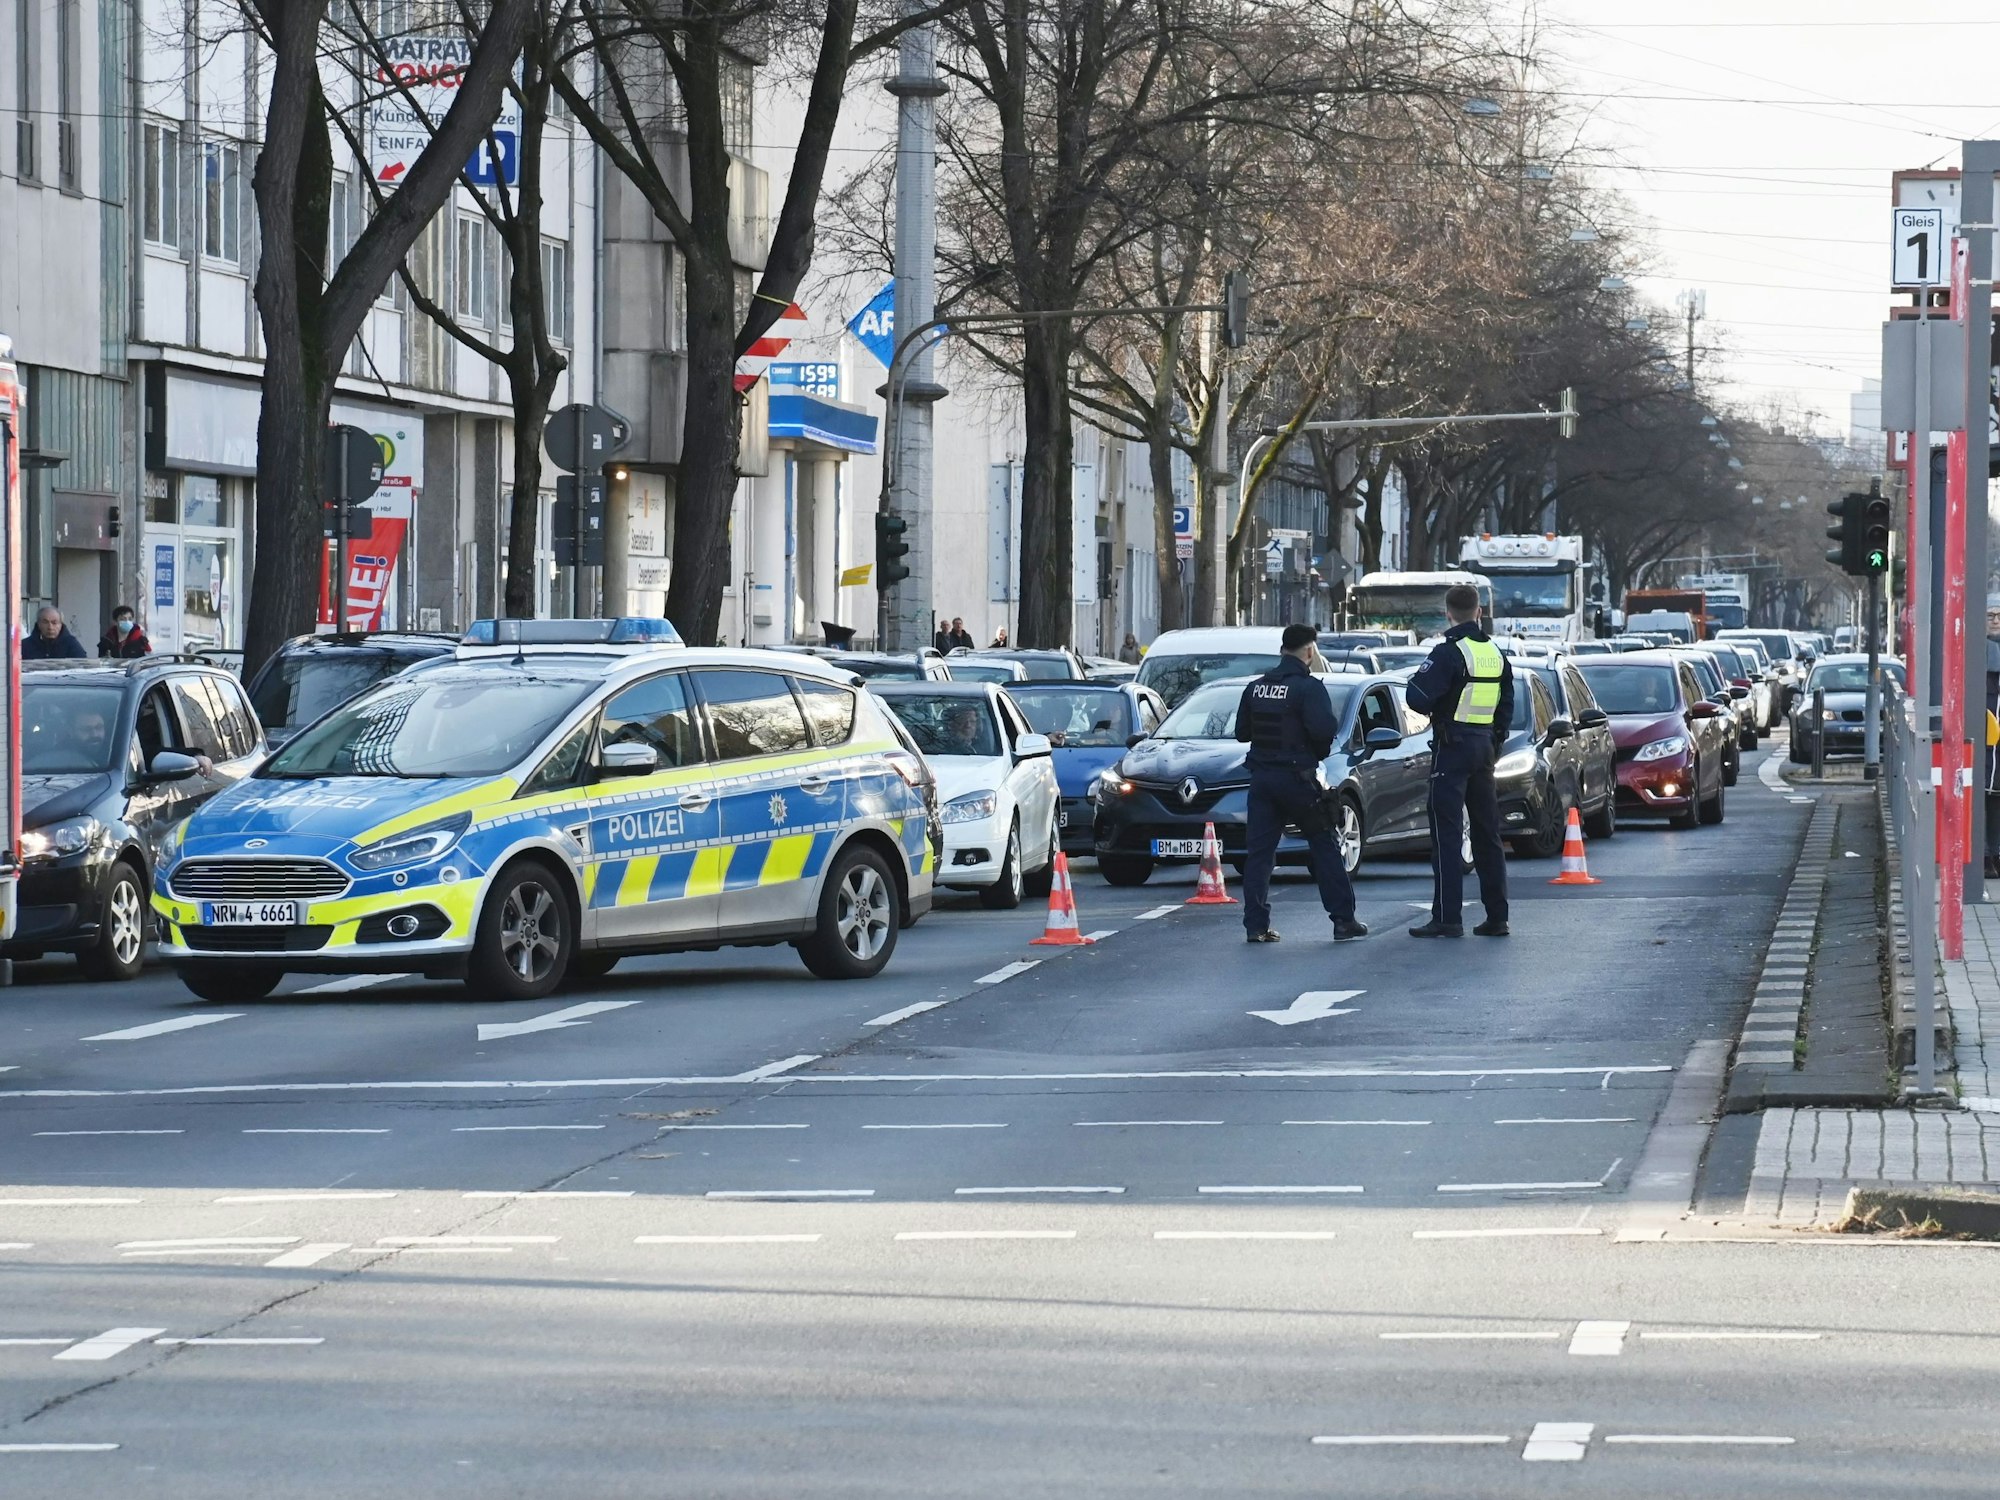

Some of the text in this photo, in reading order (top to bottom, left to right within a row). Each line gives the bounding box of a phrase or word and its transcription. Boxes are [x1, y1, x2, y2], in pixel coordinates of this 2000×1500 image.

[377, 38, 471, 62] MATRAT
[377, 63, 468, 88] CONC
[379, 136, 431, 150] EINFA
[1901, 215, 1934, 228] Gleis
[1906, 232, 1928, 279] 1
[858, 309, 895, 337] AR
[381, 477, 404, 486] straße
[346, 554, 388, 633] ALE!
[1476, 657, 1499, 669] POLIZEI
[1252, 684, 1289, 699] POLIZEI
[231, 795, 379, 811] POLIZEI
[608, 809, 685, 843] POLIZEI
[1158, 840, 1172, 853] BM
[1179, 840, 1193, 853] MB
[212, 904, 237, 923] NRW
